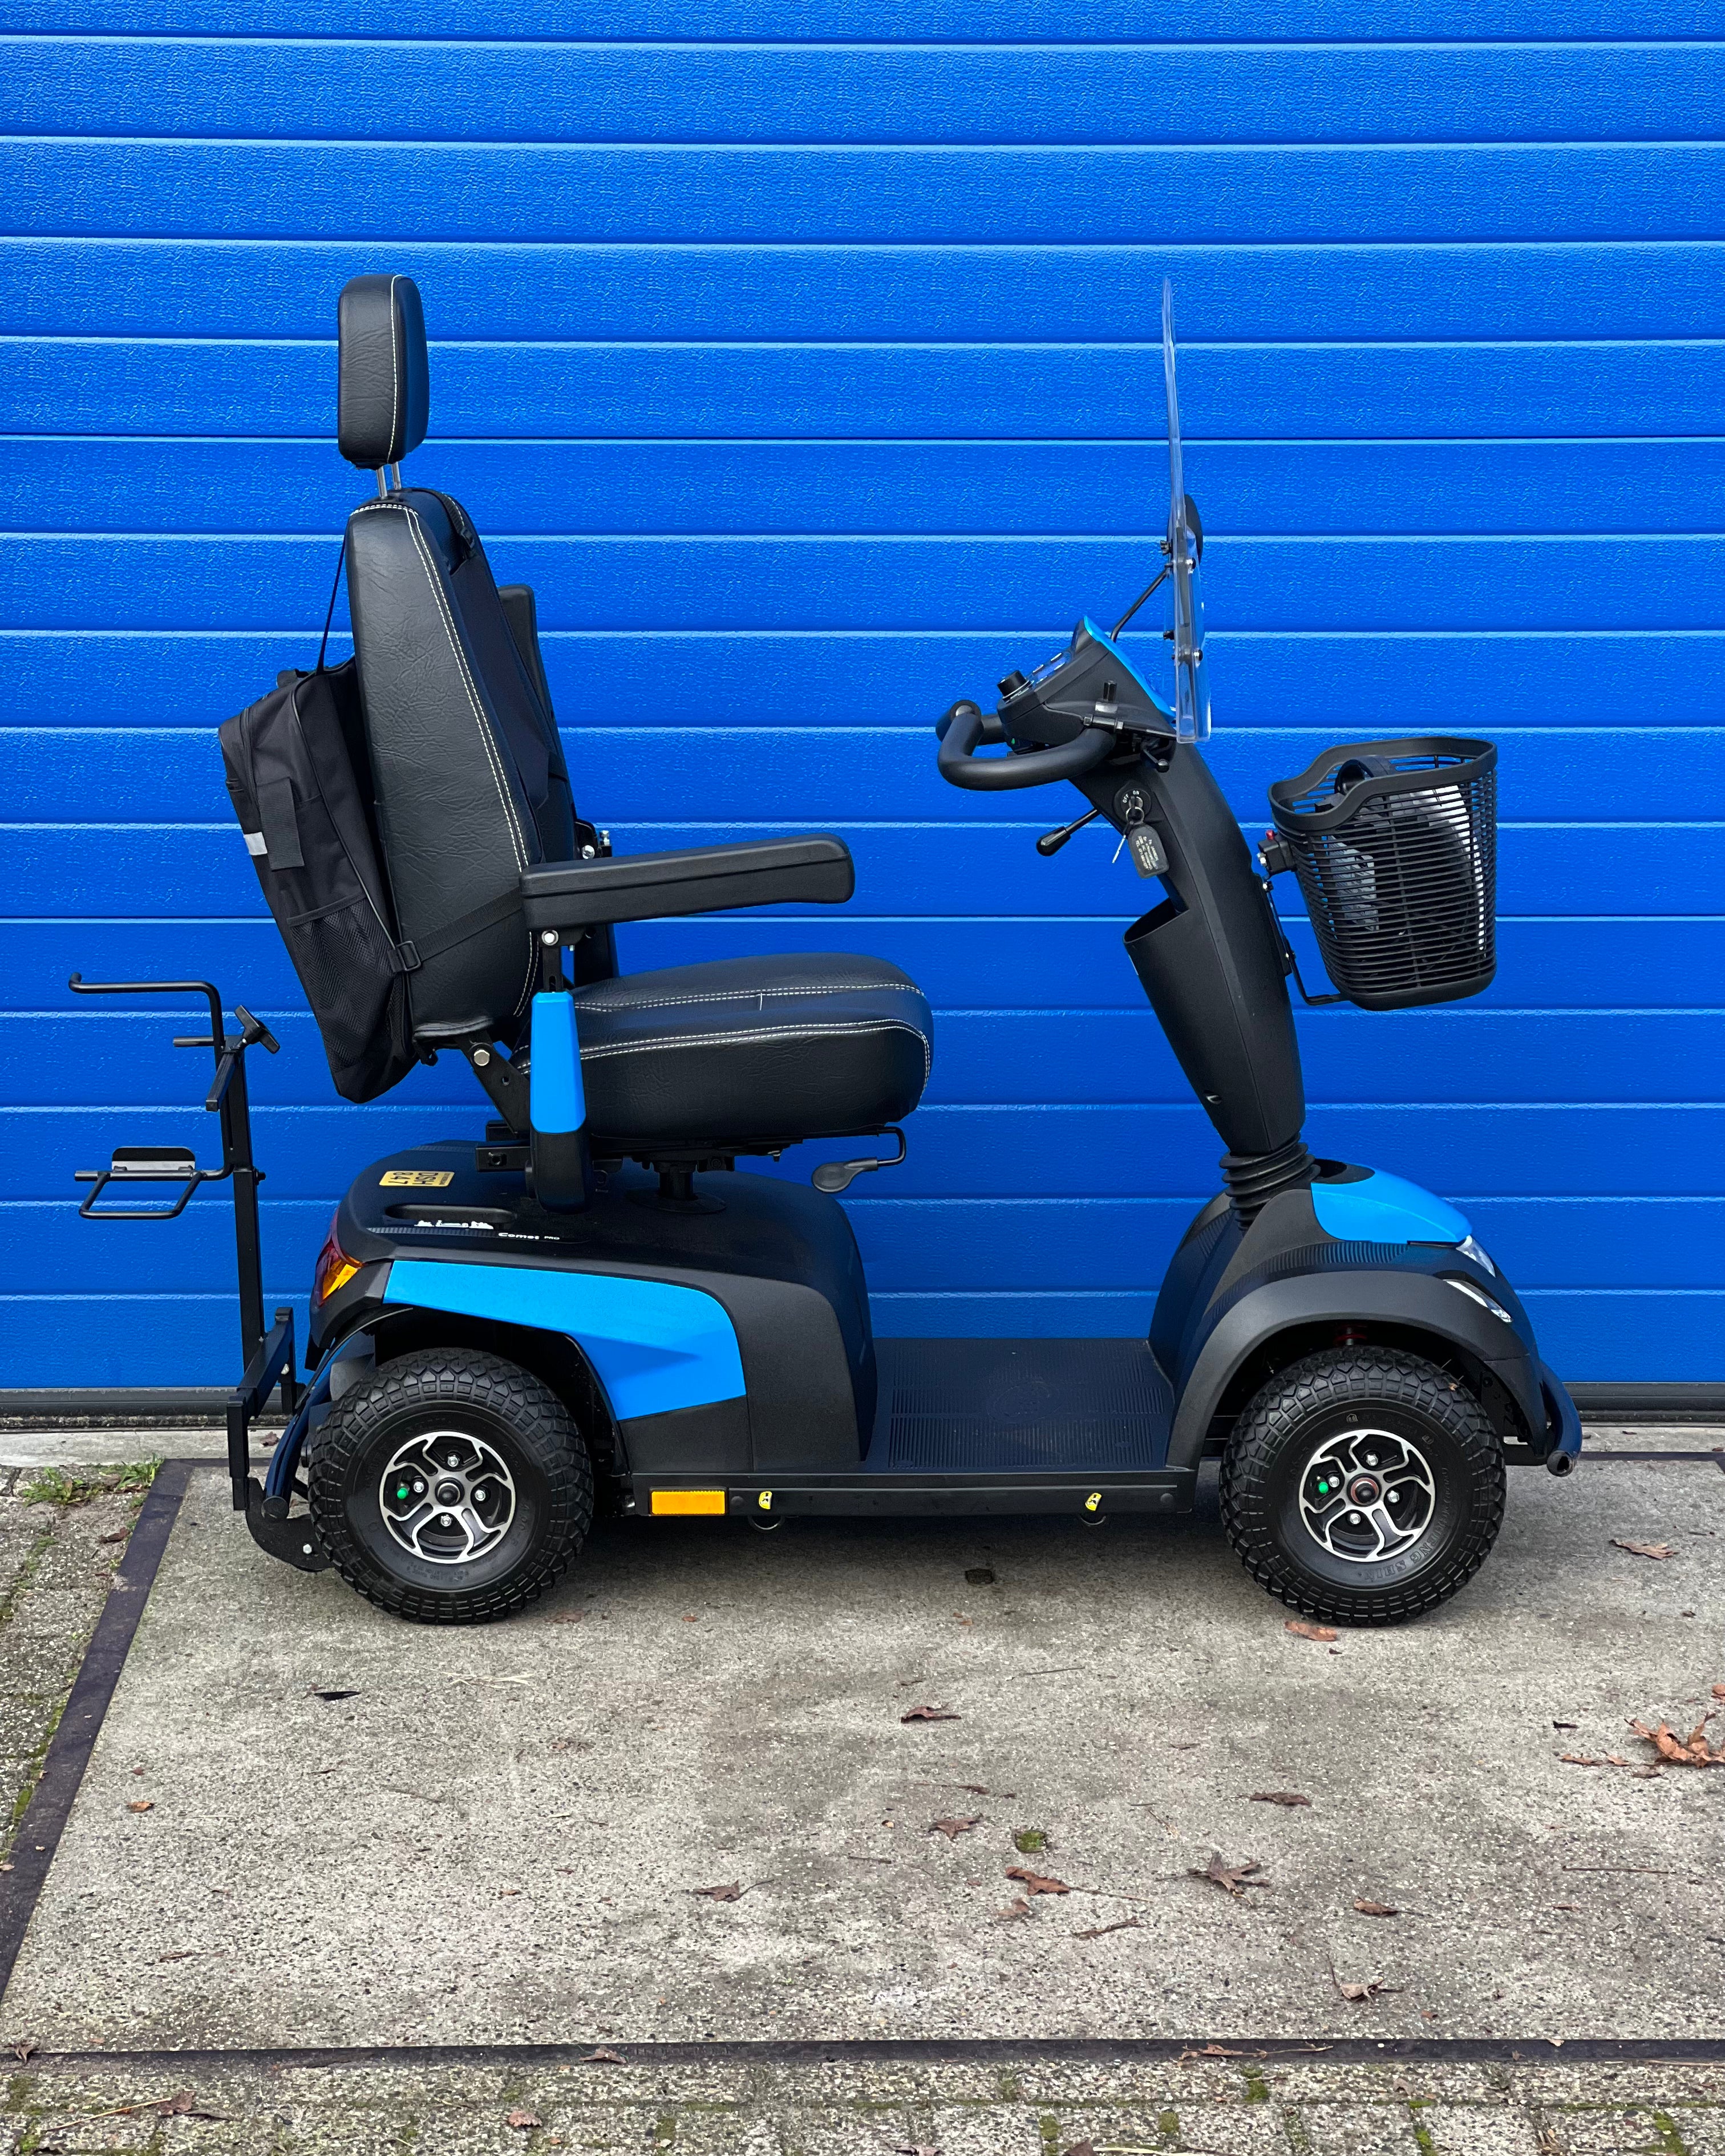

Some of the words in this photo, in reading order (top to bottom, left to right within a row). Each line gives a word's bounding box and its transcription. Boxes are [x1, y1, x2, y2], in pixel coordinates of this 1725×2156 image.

[388, 1172, 414, 1185] 847
[412, 1172, 439, 1185] DSH
[1364, 1559, 1407, 1580] SHIN
